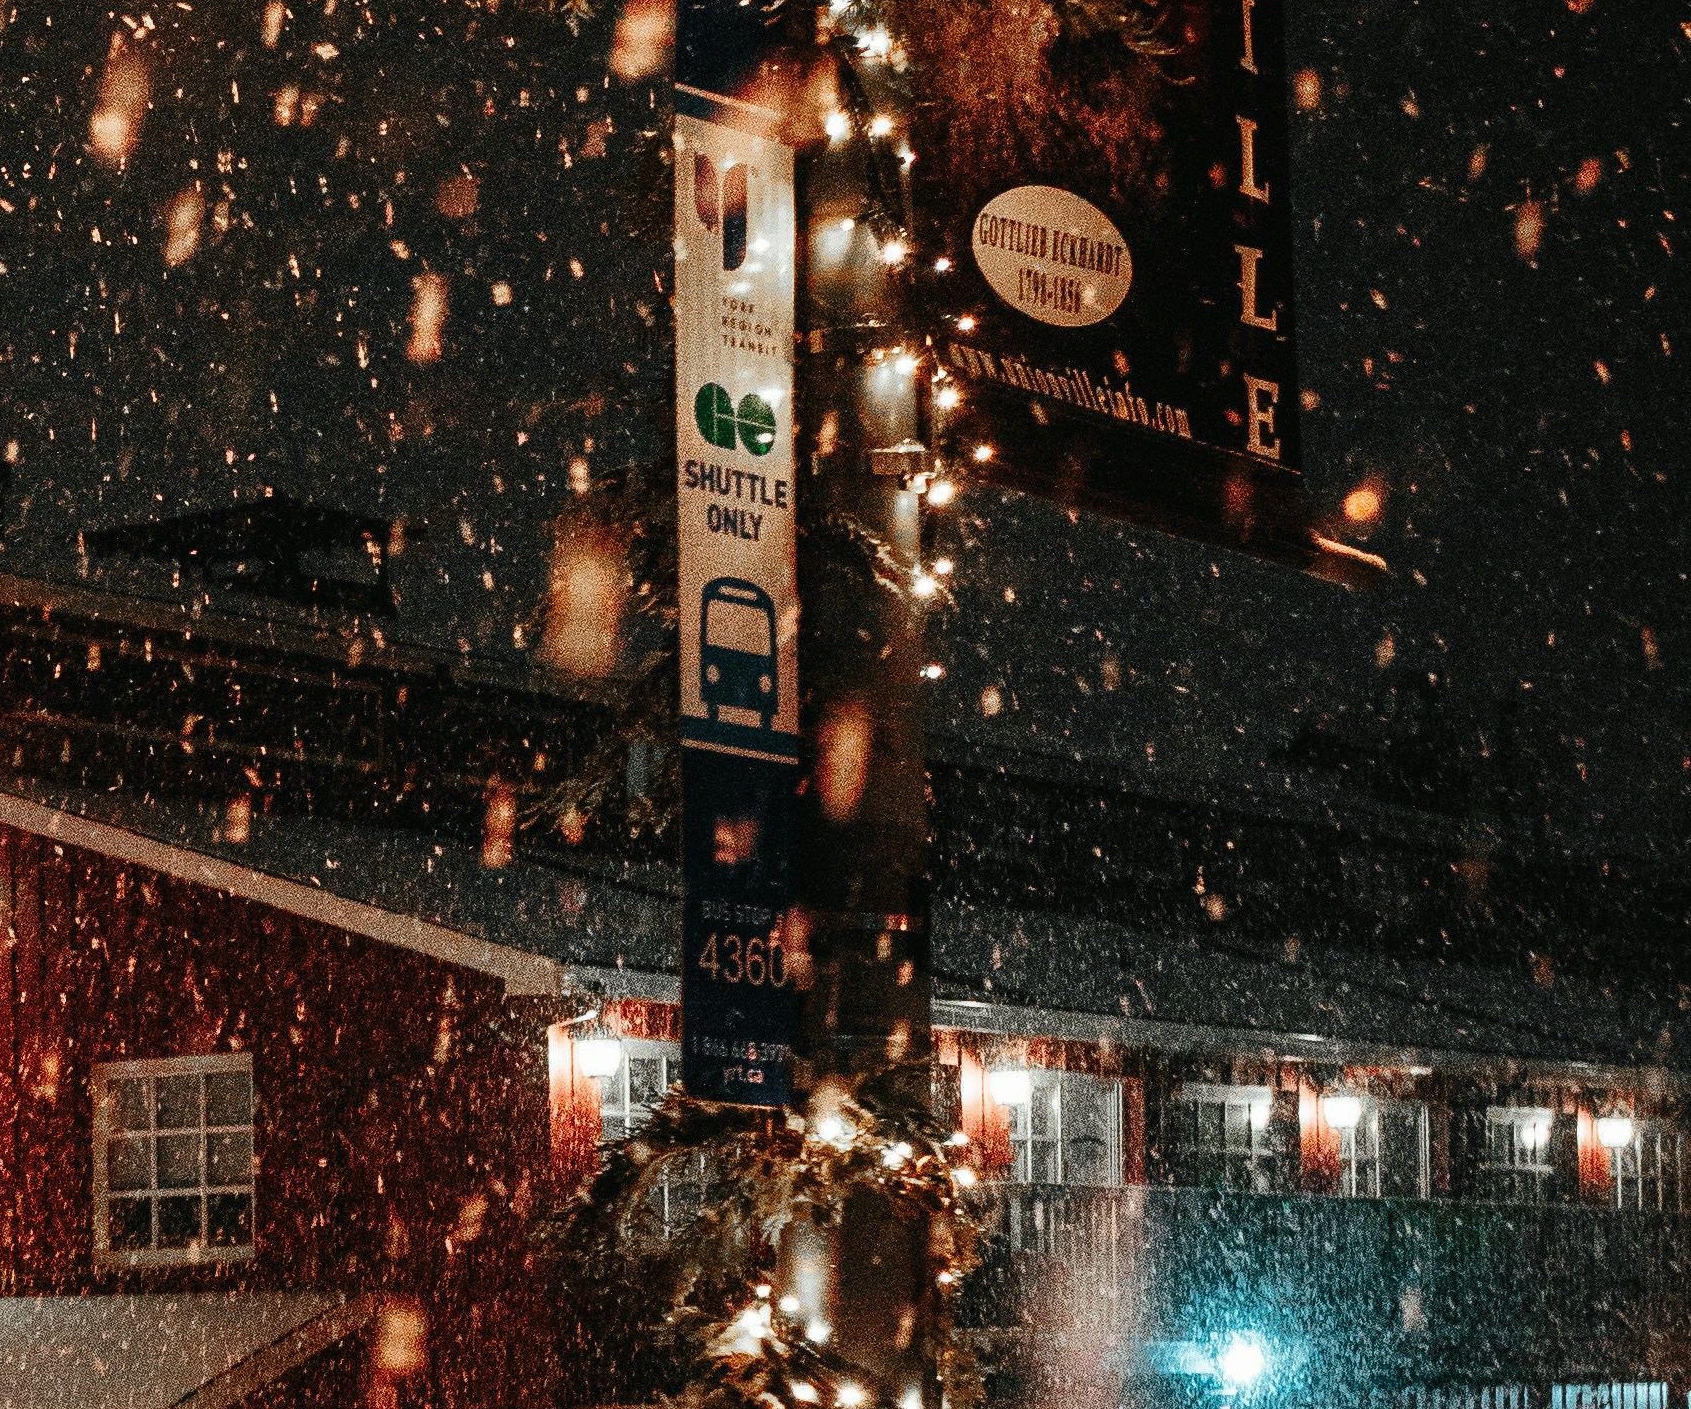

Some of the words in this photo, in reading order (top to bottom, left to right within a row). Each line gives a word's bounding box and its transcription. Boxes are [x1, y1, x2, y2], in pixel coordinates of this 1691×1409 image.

[979, 213, 1047, 258] GOTTLIEB
[1052, 230, 1123, 277] ECKHARDT
[721, 316, 772, 337] REGION
[721, 334, 777, 356] TRANSIT
[684, 458, 788, 510] SHUTTLE
[707, 504, 763, 542] ONLY
[701, 899, 731, 922] BUS
[698, 932, 788, 989] 4360
